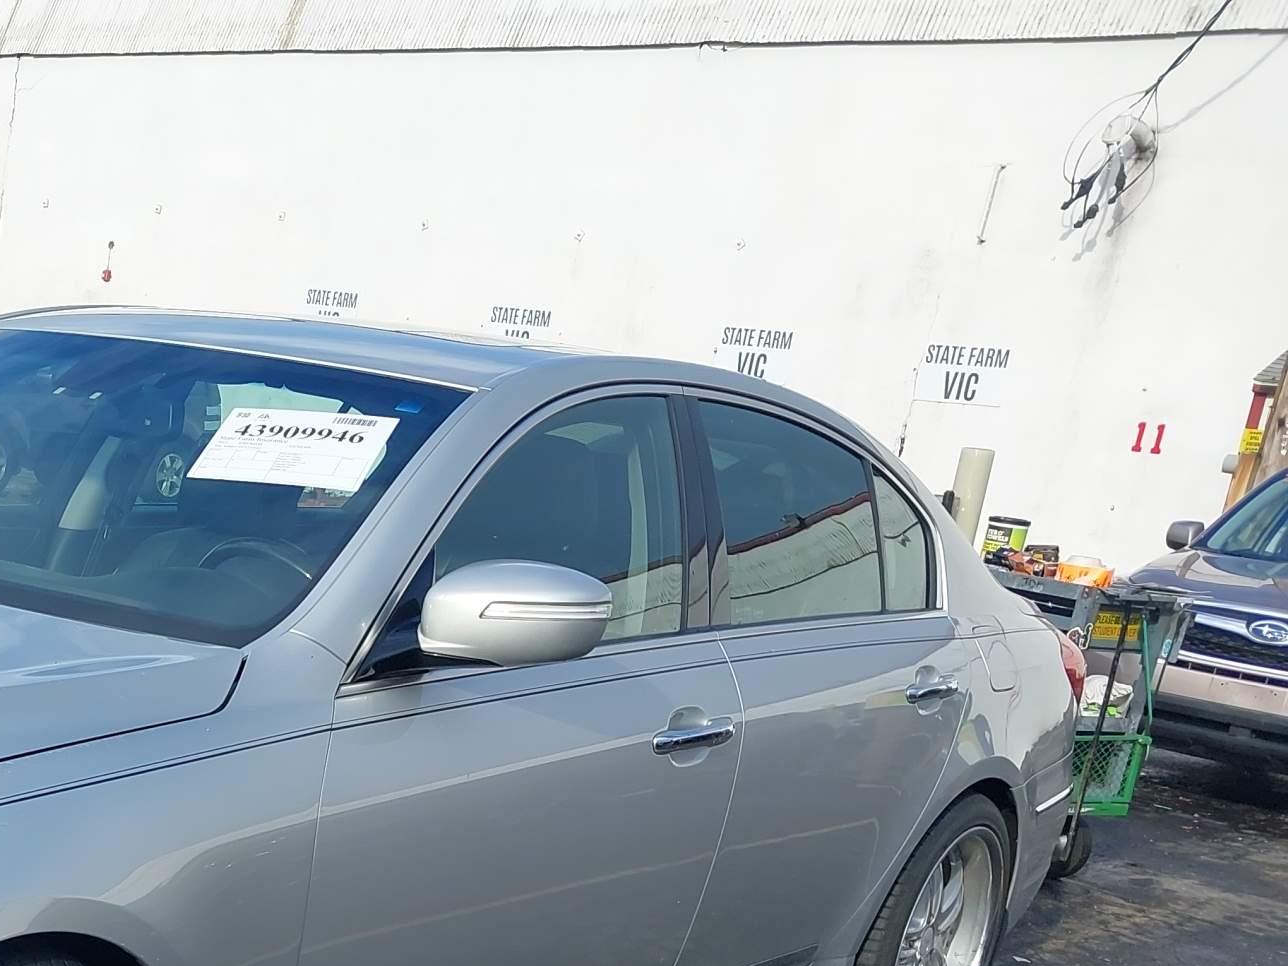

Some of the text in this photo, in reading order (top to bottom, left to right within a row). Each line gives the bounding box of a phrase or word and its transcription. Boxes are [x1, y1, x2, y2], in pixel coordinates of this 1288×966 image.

[306, 288, 358, 309] STATE FARM
[490, 306, 552, 328] STATE FARM
[721, 326, 793, 350] STATE FARM
[737, 351, 767, 379] VIC
[925, 344, 1010, 369] STATE FARM
[943, 371, 979, 402] VIC
[234, 423, 370, 444] 43909946
[1131, 421, 1166, 454] 11
